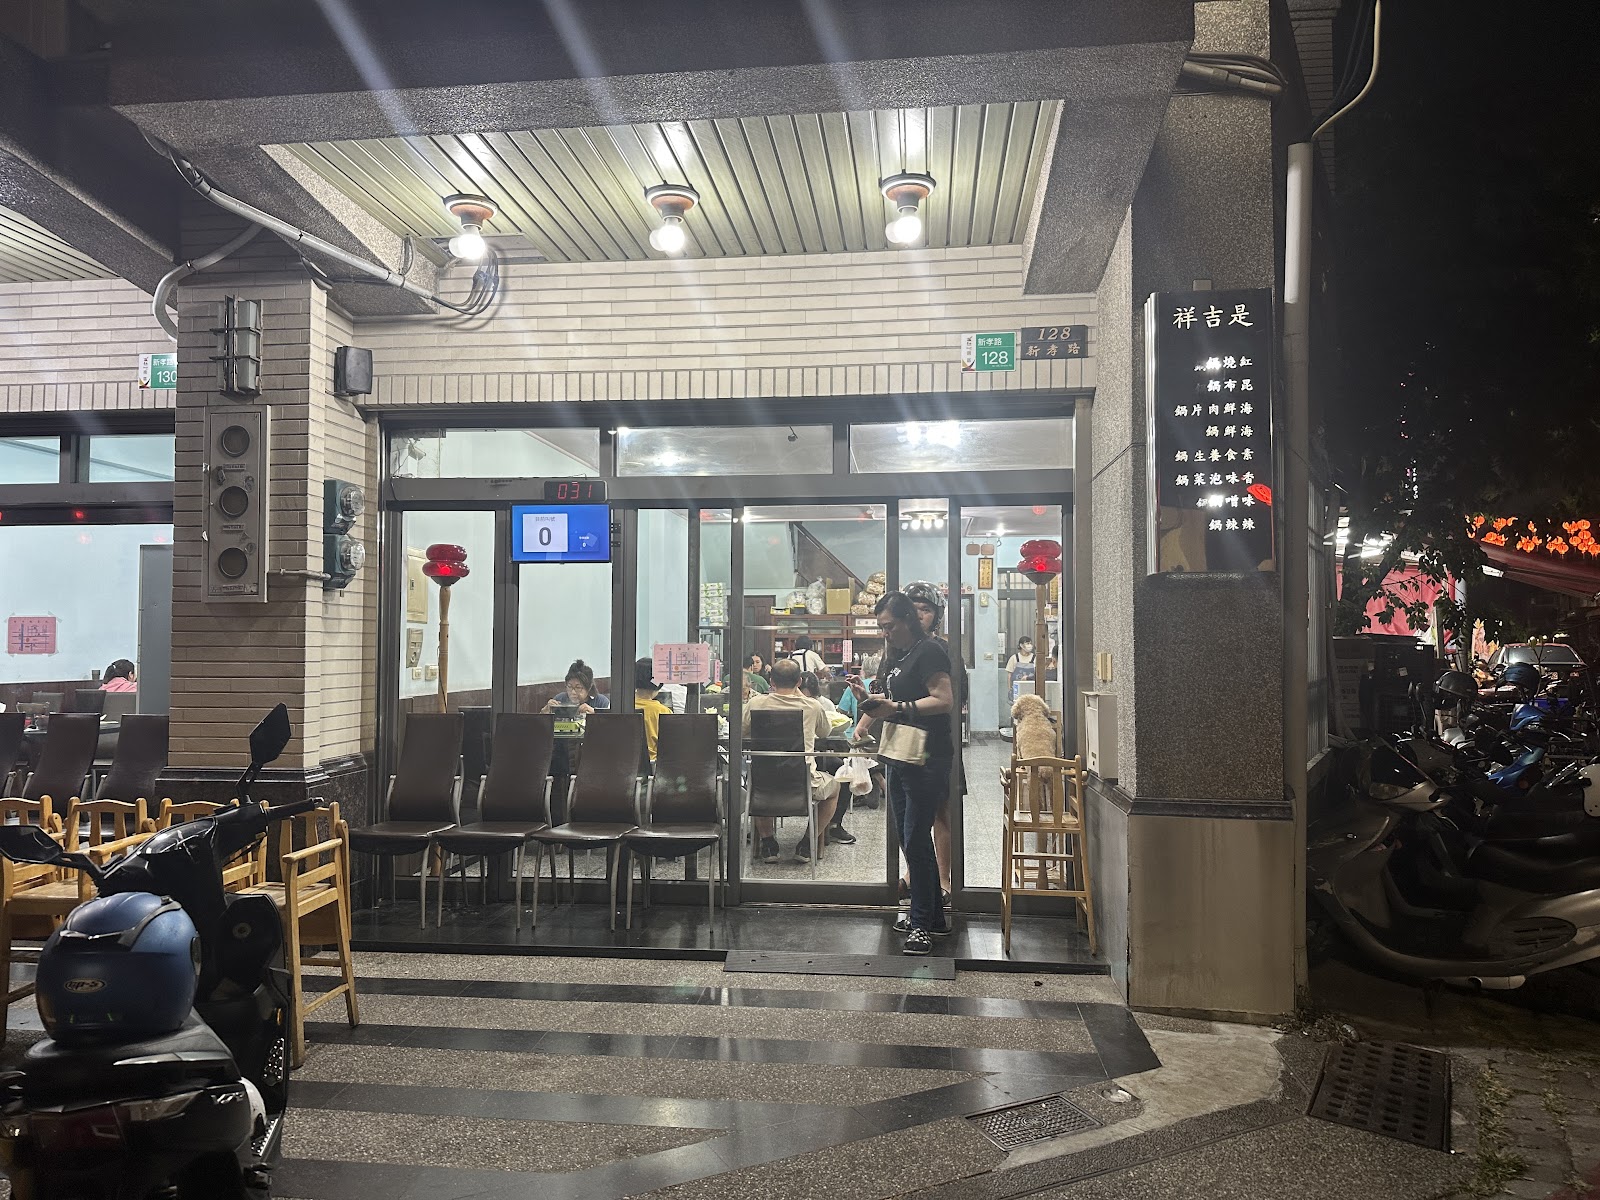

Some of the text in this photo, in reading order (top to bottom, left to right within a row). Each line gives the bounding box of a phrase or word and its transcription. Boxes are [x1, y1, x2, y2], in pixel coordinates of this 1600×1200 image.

[1037, 326, 1071, 341] 128
[977, 337, 1002, 347] 新孝路
[981, 351, 1009, 365] 128
[1026, 343, 1081, 358] 新孝路
[156, 370, 177, 383] 130
[557, 482, 593, 500] 031
[538, 526, 552, 546] 0
